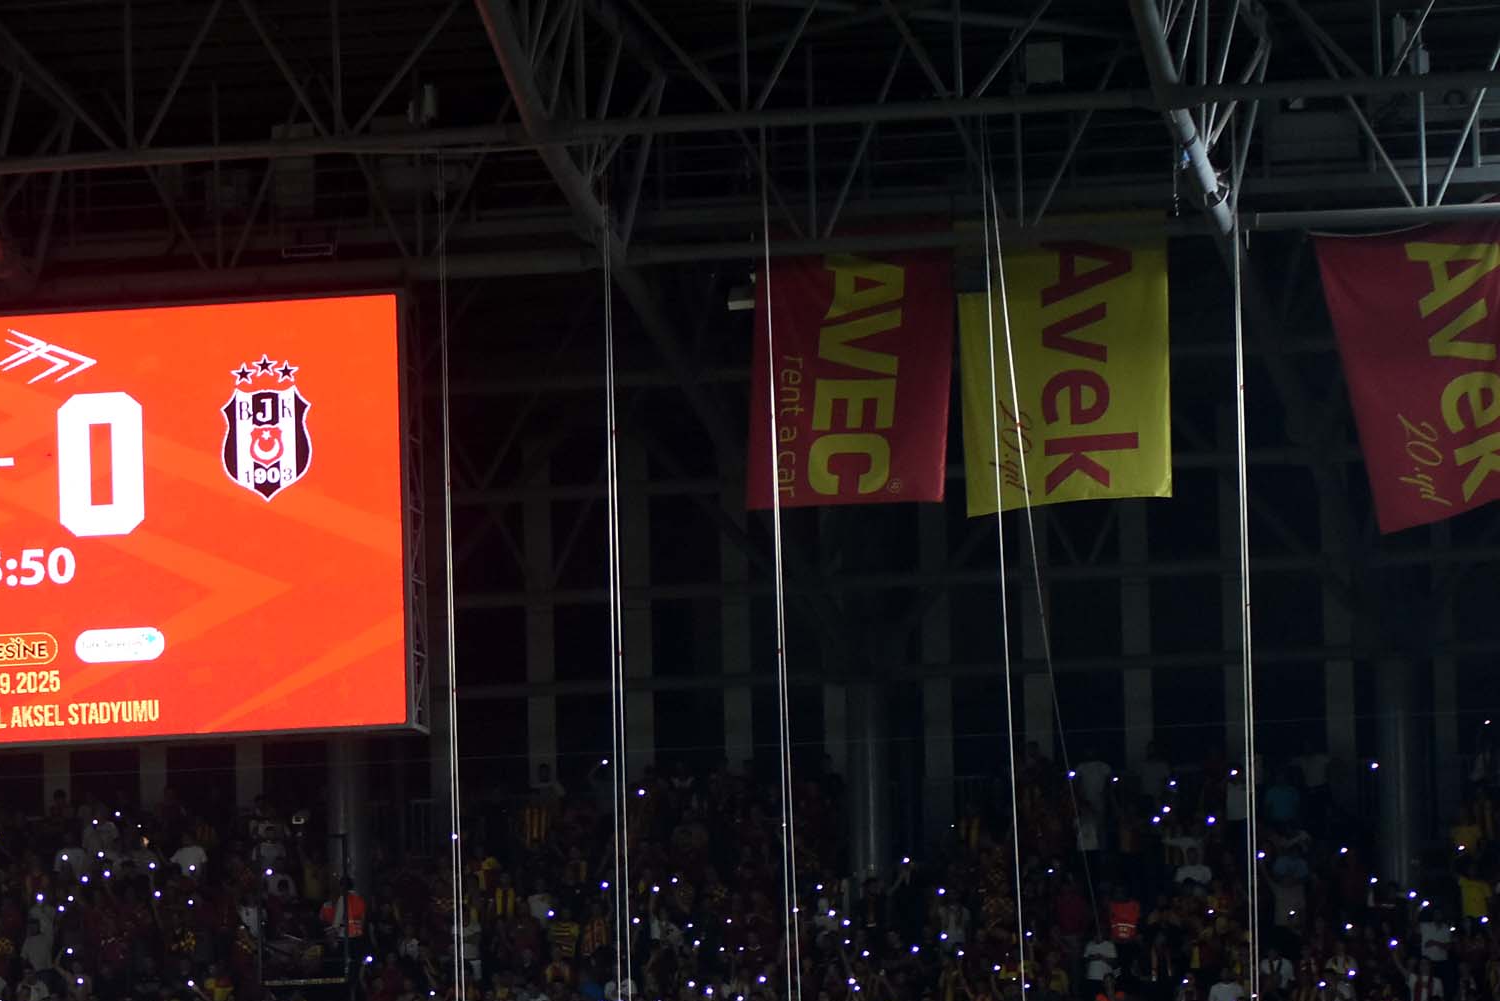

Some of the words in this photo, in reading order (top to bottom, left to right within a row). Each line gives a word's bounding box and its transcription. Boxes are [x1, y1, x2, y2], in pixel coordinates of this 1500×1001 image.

[780, 354, 805, 417] rent
[808, 252, 905, 497] AVEC
[1041, 241, 1139, 496] Avek
[1404, 241, 1500, 503] Avek
[239, 398, 293, 422] BJK
[57, 391, 146, 538] 0
[244, 466, 293, 485] 1903
[776, 448, 798, 499] car
[9, 704, 65, 728] AKSEL
[67, 699, 160, 725] STADYUMU
